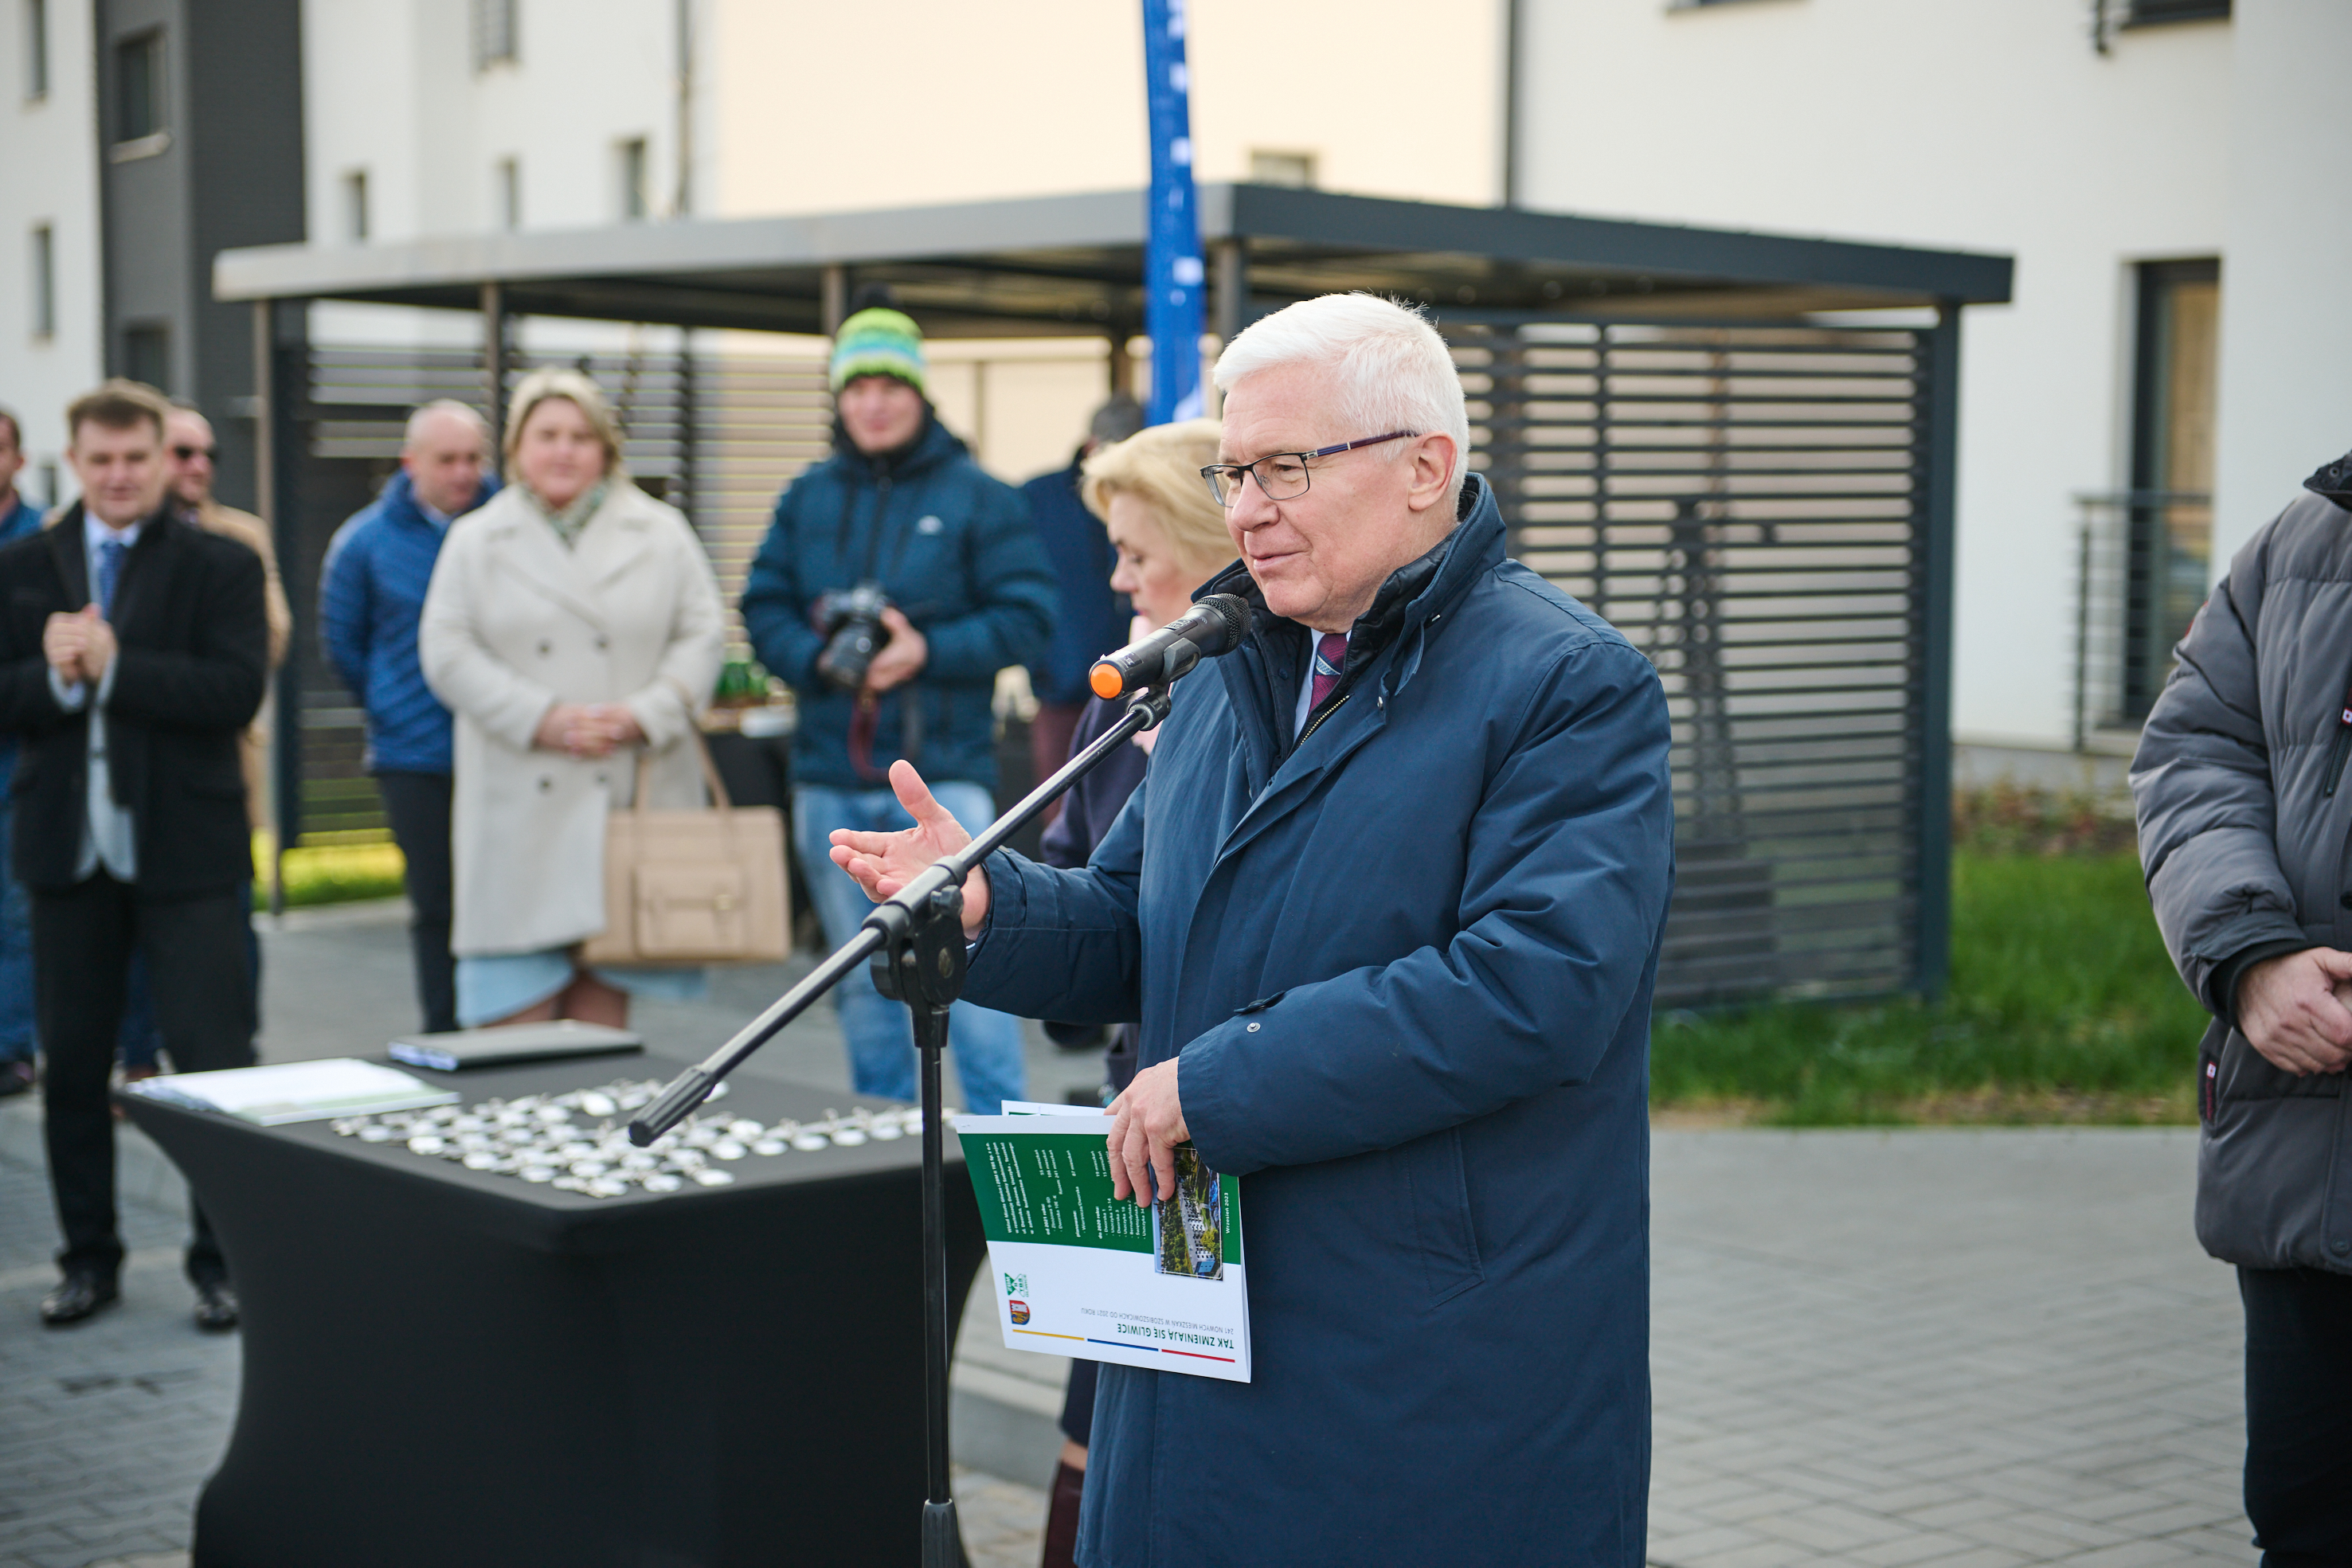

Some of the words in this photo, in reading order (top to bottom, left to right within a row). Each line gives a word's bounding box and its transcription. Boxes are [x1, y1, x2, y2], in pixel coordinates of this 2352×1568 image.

[996, 1155, 1007, 1182] Szobiszowice
[1034, 1150, 1043, 1169] mieszkań
[1041, 1150, 1050, 1169] mieszkań
[1048, 1150, 1057, 1169] mieszkań
[1066, 1150, 1074, 1170] mieszkań
[1090, 1151, 1099, 1171] mieszkań
[1098, 1151, 1106, 1171] mieszkań
[1019, 1180, 1029, 1208] budownictwa
[1119, 1312, 1164, 1325] SZOBISZOWICACH
[1171, 1320, 1198, 1329] MIESZKAŃ
[1117, 1323, 1151, 1337] GLIWICE
[1154, 1326, 1166, 1339] SIĘ
[1168, 1328, 1215, 1347] ZMIENIAJĄ
[1199, 1324, 1223, 1333] NOWYCH
[1217, 1337, 1234, 1349] TAK
